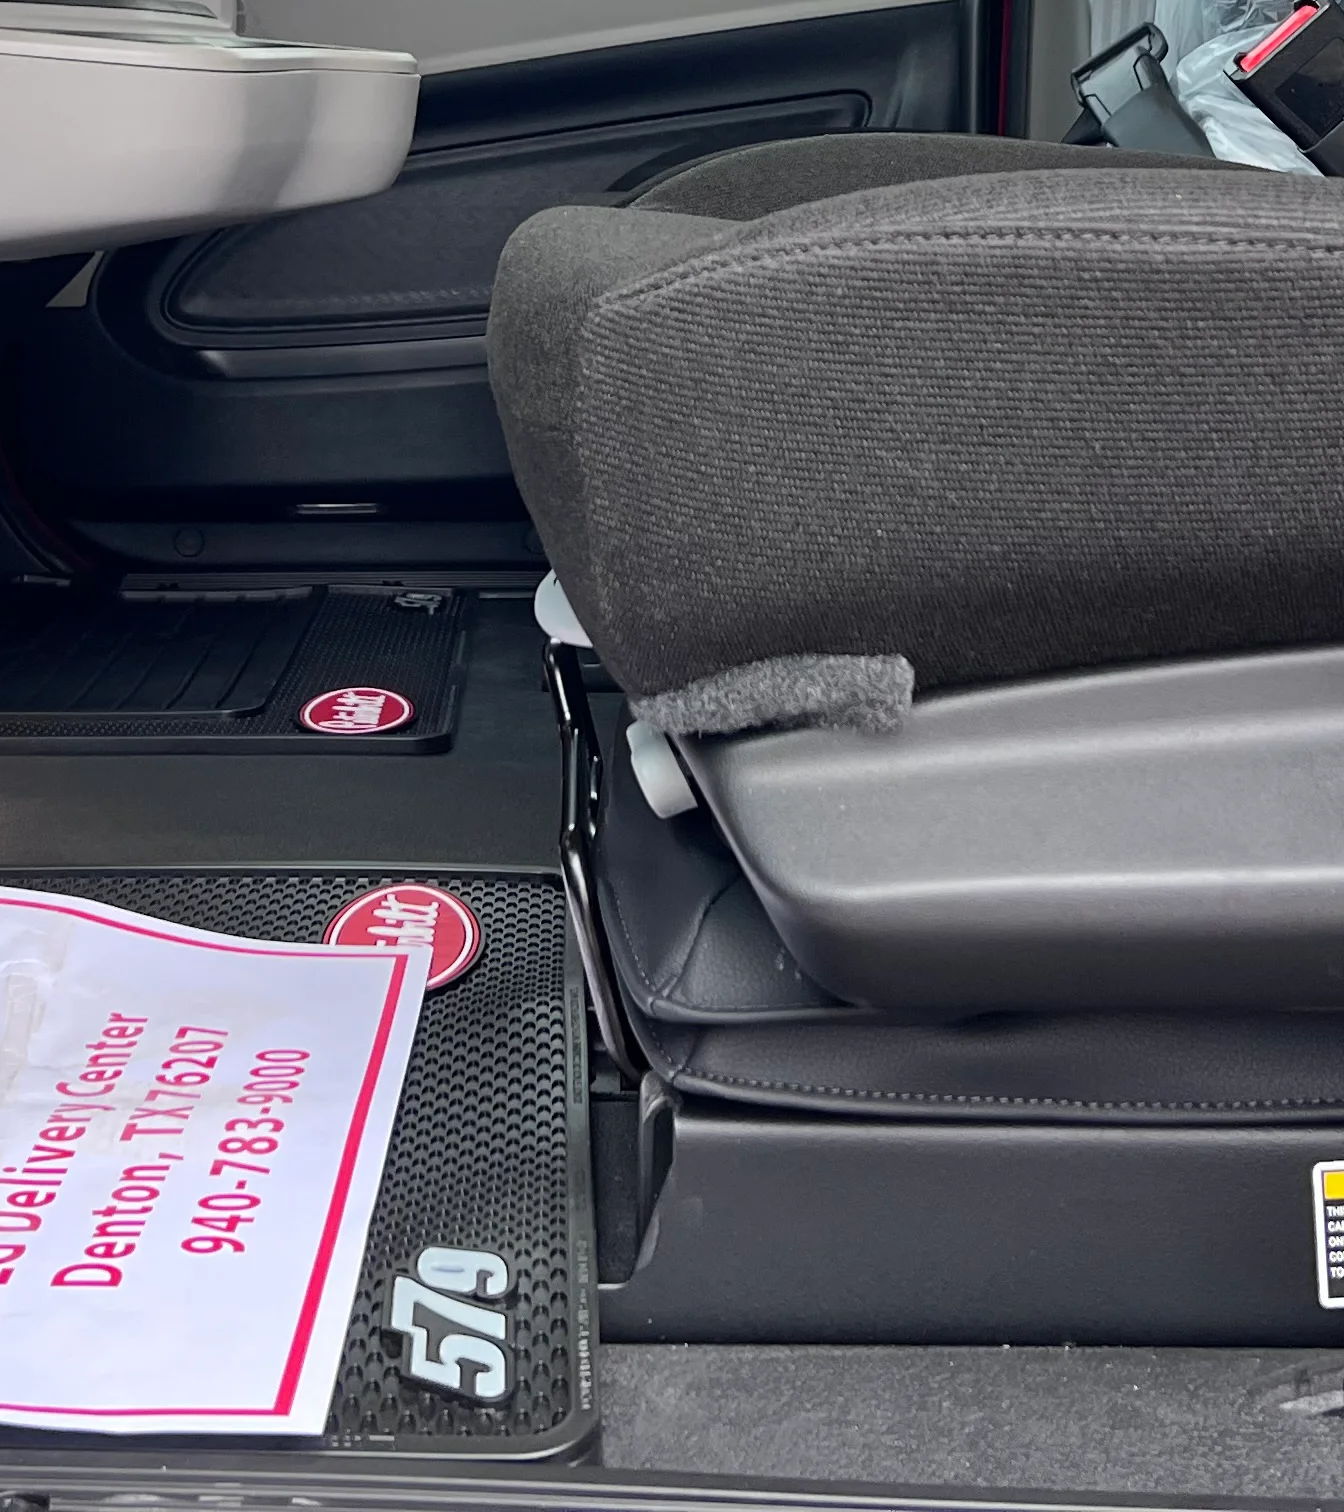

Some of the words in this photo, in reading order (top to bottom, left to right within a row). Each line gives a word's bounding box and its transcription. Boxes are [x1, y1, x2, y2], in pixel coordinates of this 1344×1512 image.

[55, 1011, 149, 1098] Center
[143, 1024, 230, 1102] 76207
[119, 1104, 196, 1143] TX
[179, 1048, 312, 1255] 940-783-9000
[49, 1150, 186, 1289] Denton,
[1330, 1265, 1344, 1278] TO
[391, 1246, 509, 1398] 579
